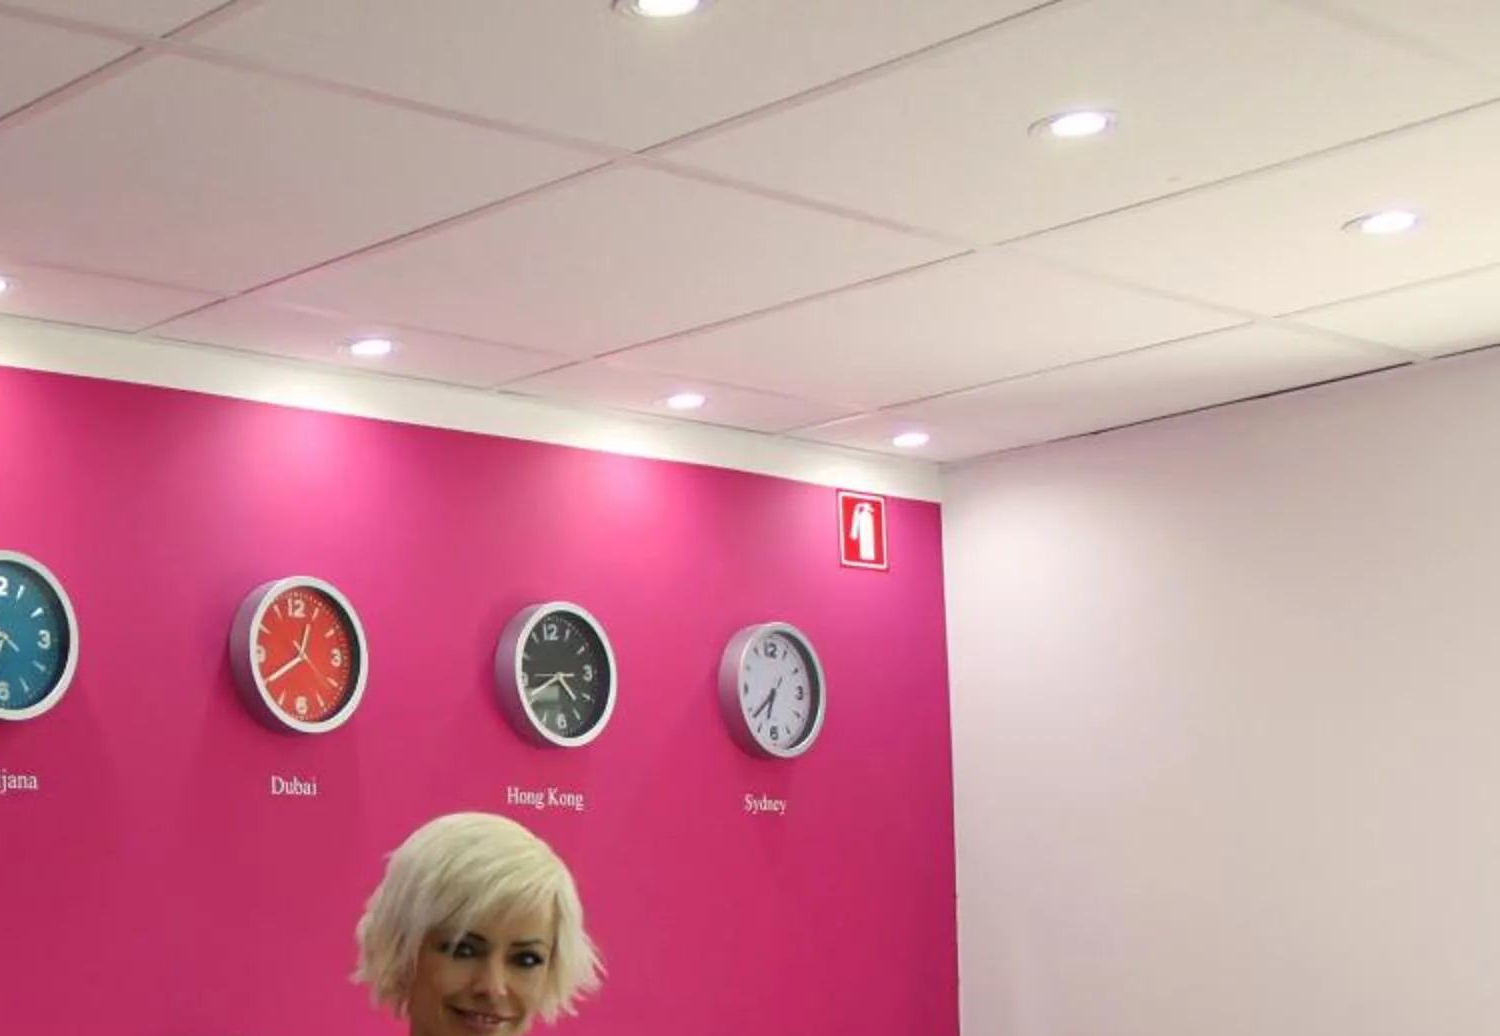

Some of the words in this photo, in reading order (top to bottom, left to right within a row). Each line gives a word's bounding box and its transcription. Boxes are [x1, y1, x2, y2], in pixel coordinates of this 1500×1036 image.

[287, 599, 306, 618] 12
[37, 629, 51, 649] 3
[543, 623, 560, 641] 12
[330, 648, 342, 667] 3
[763, 642, 778, 659] 12
[582, 665, 594, 681] 3
[795, 686, 804, 701] 3
[295, 696, 308, 715] 6
[556, 713, 568, 729] 6
[769, 726, 779, 741] 6
[270, 775, 318, 796] Dubai
[506, 786, 546, 809] Hong
[547, 788, 585, 811] Kong
[743, 793, 787, 815] Sydney
